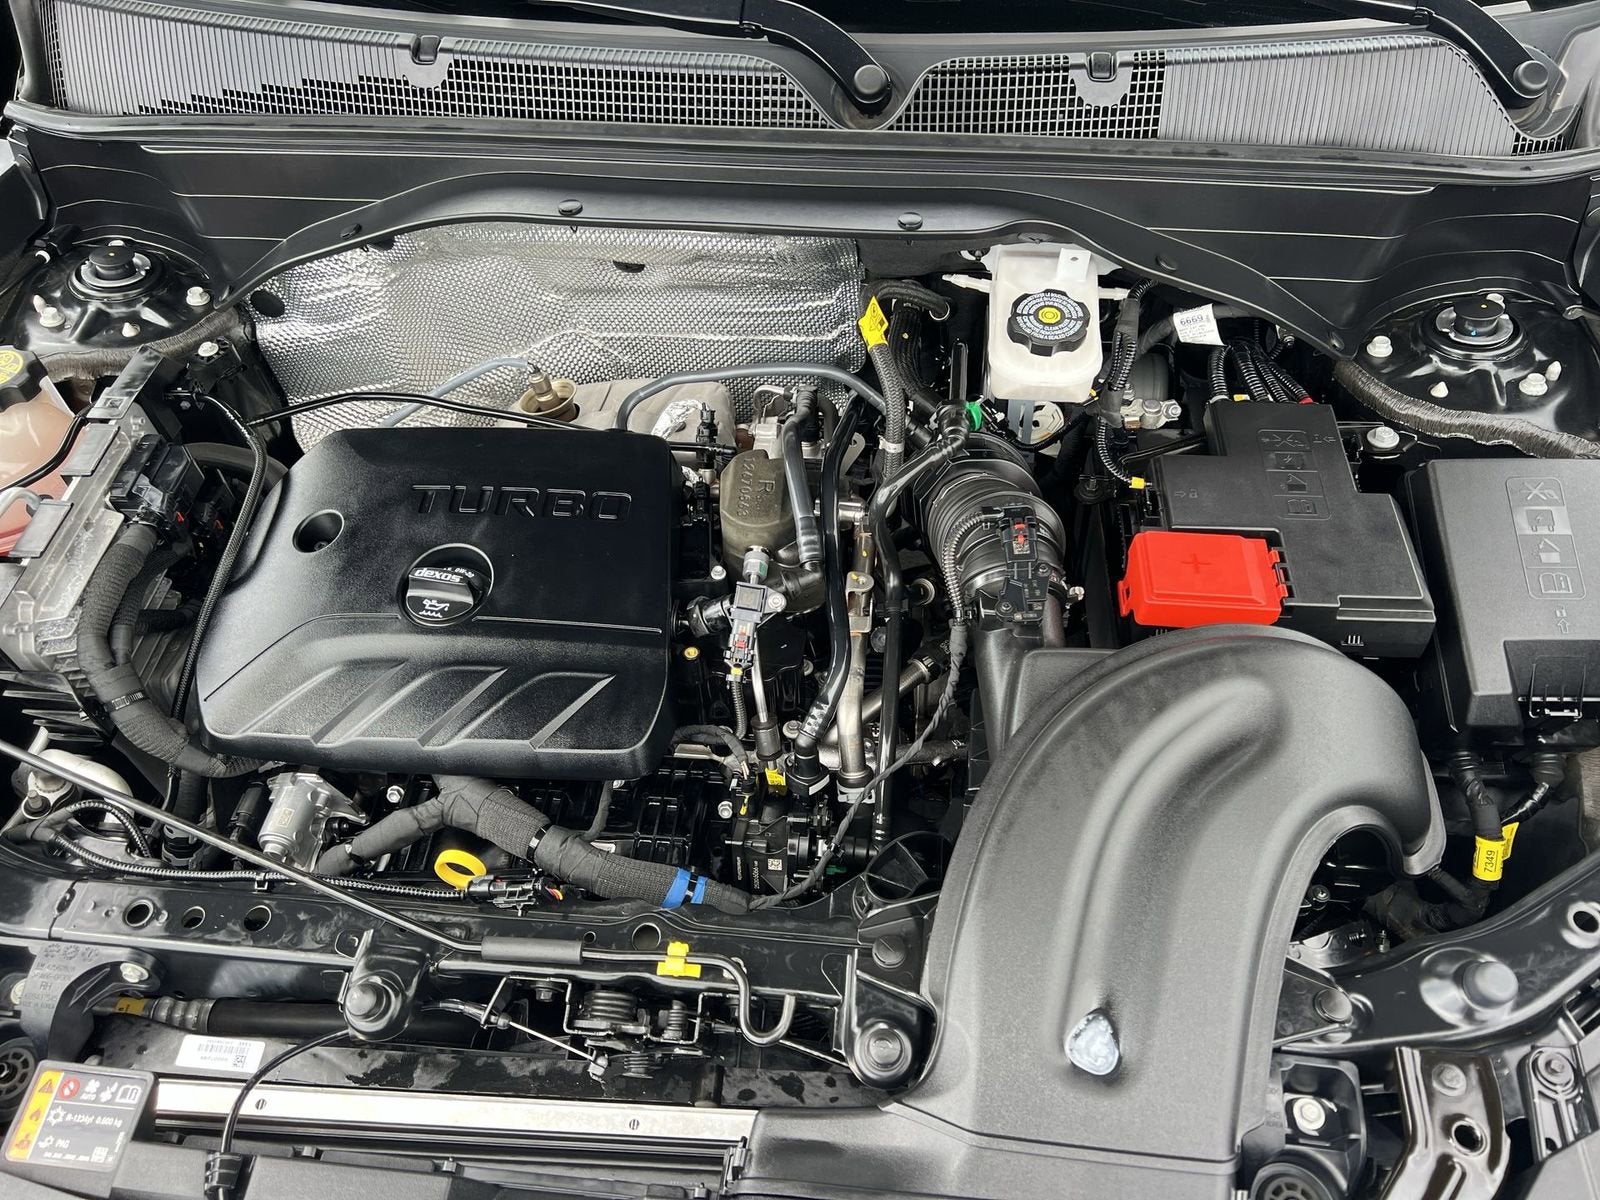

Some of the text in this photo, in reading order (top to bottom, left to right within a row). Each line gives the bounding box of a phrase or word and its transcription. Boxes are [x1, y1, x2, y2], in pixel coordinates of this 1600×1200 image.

[1180, 314, 1204, 326] 6669
[411, 484, 633, 522] TURBO
[414, 567, 464, 582] dexos
[1484, 850, 1496, 873] 7349
